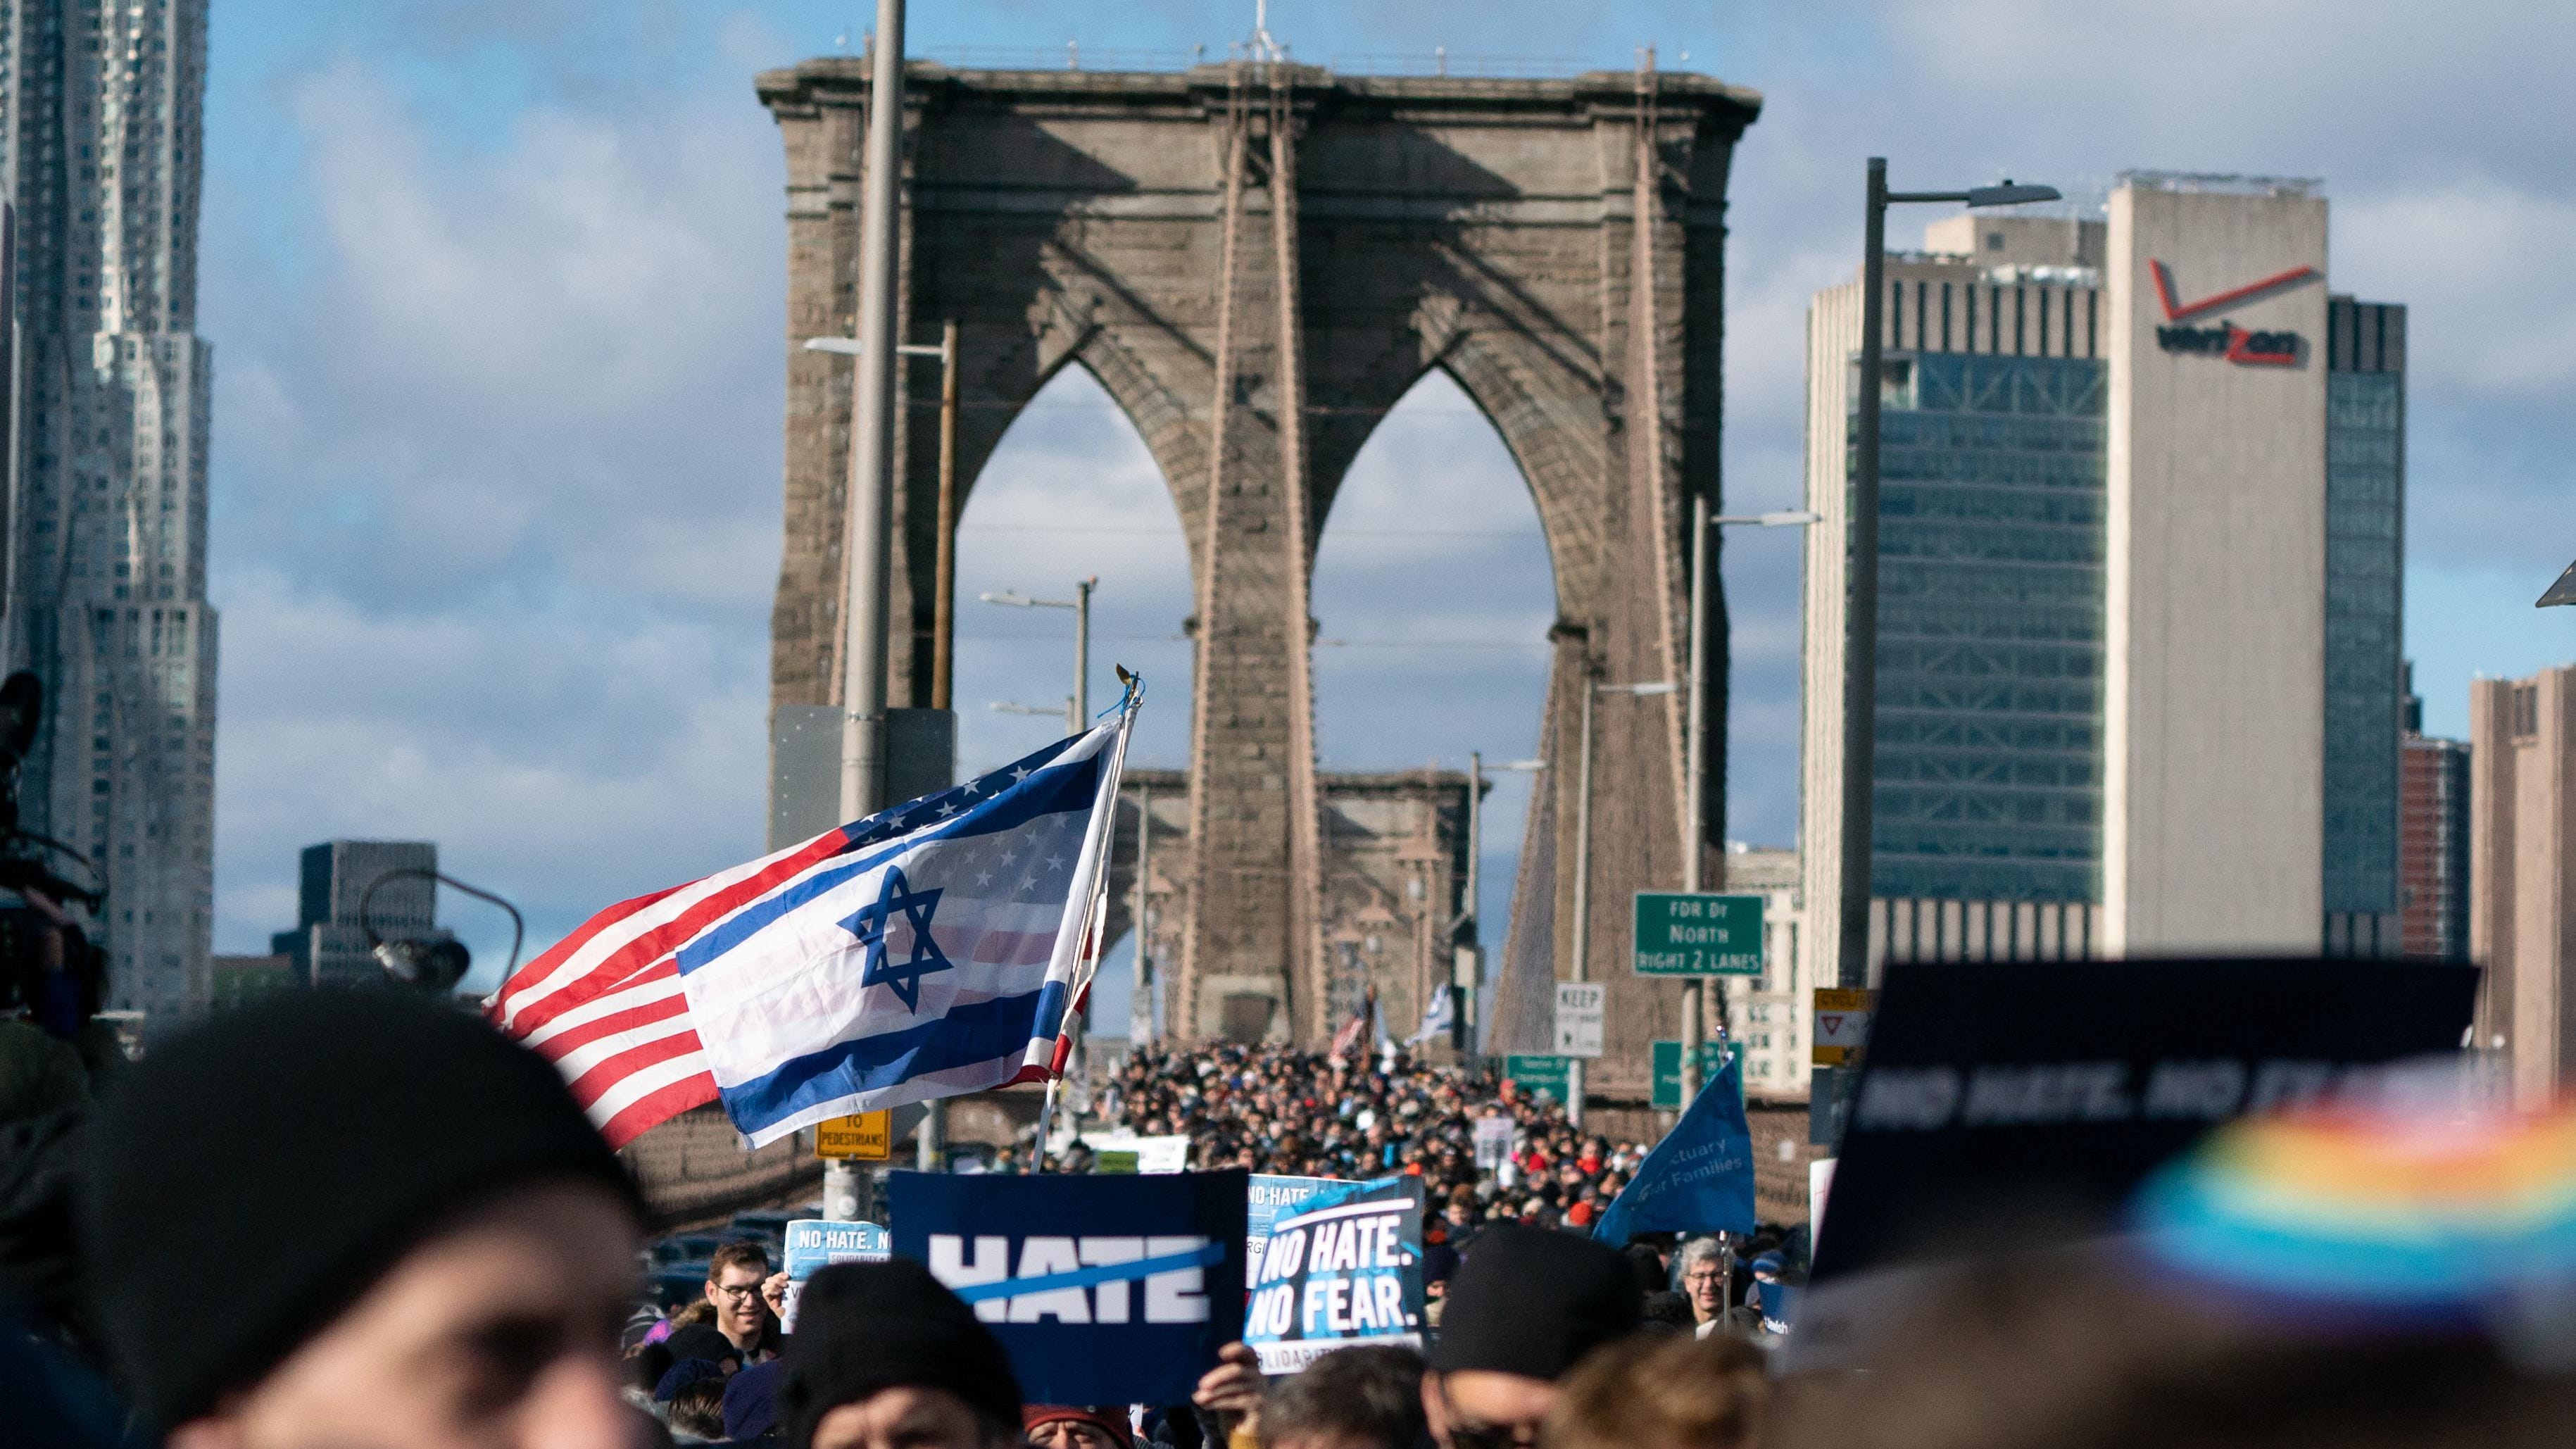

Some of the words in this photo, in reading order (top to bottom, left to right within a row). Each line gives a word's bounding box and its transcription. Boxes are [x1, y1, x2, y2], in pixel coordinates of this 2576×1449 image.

[2156, 319, 2297, 365] verizon
[1669, 897, 1702, 917] FDR
[1638, 951, 1685, 970] RIGHT
[1693, 951, 1703, 970] 2
[1709, 953, 1759, 970] LANES
[1561, 989, 1600, 1008] KEEP
[846, 1115, 862, 1128] TO
[822, 1132, 884, 1147] PEDESTRIANS
[1248, 1186, 1265, 1205] NO
[799, 1231, 822, 1249] NO
[826, 1231, 872, 1250] HATE.
[1261, 1229, 1307, 1285] NO
[1308, 1215, 1413, 1273] HATE.
[831, 1255, 878, 1264] SOLIDARITY
[929, 1234, 1211, 1324] HATE
[1245, 1284, 1295, 1338] NO
[1303, 1274, 1418, 1333] FEAR.
